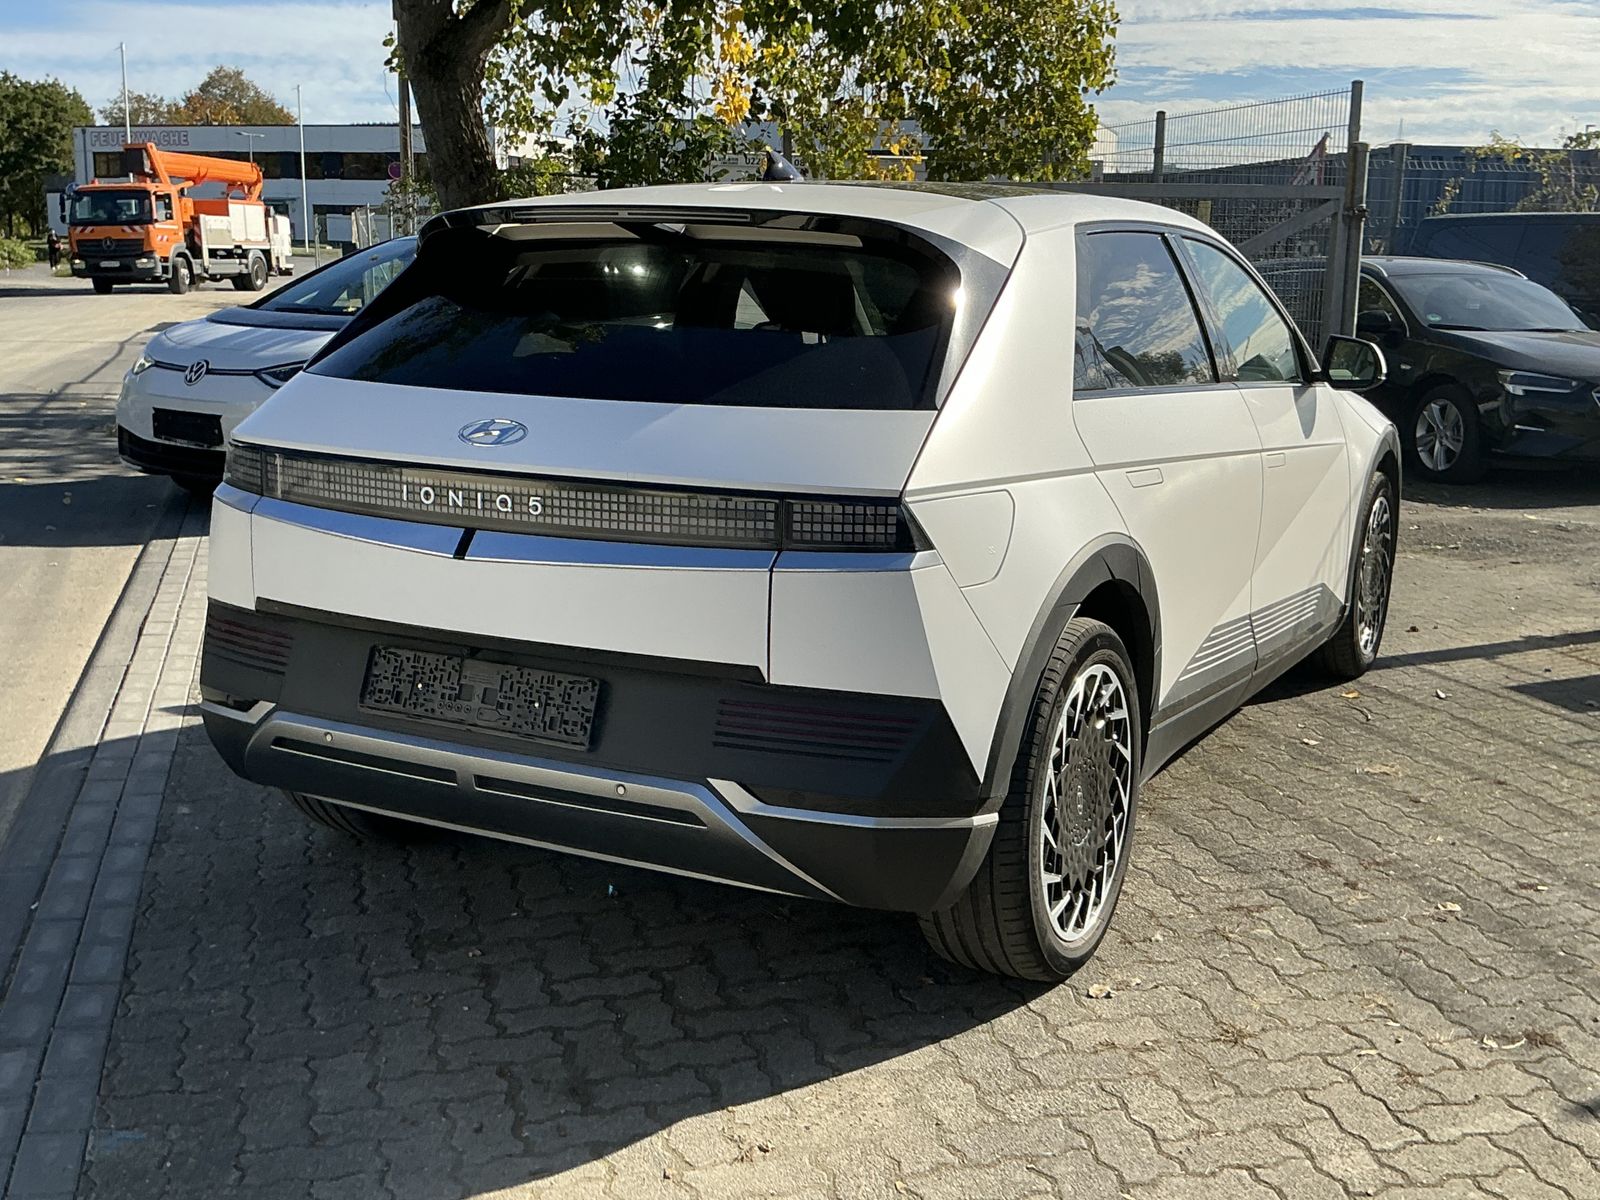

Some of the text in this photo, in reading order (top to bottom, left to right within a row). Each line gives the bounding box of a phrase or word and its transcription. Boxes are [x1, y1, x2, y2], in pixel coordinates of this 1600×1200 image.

[90, 130, 189, 146] FEUERWACHE
[402, 485, 543, 515] IONIQ 5
